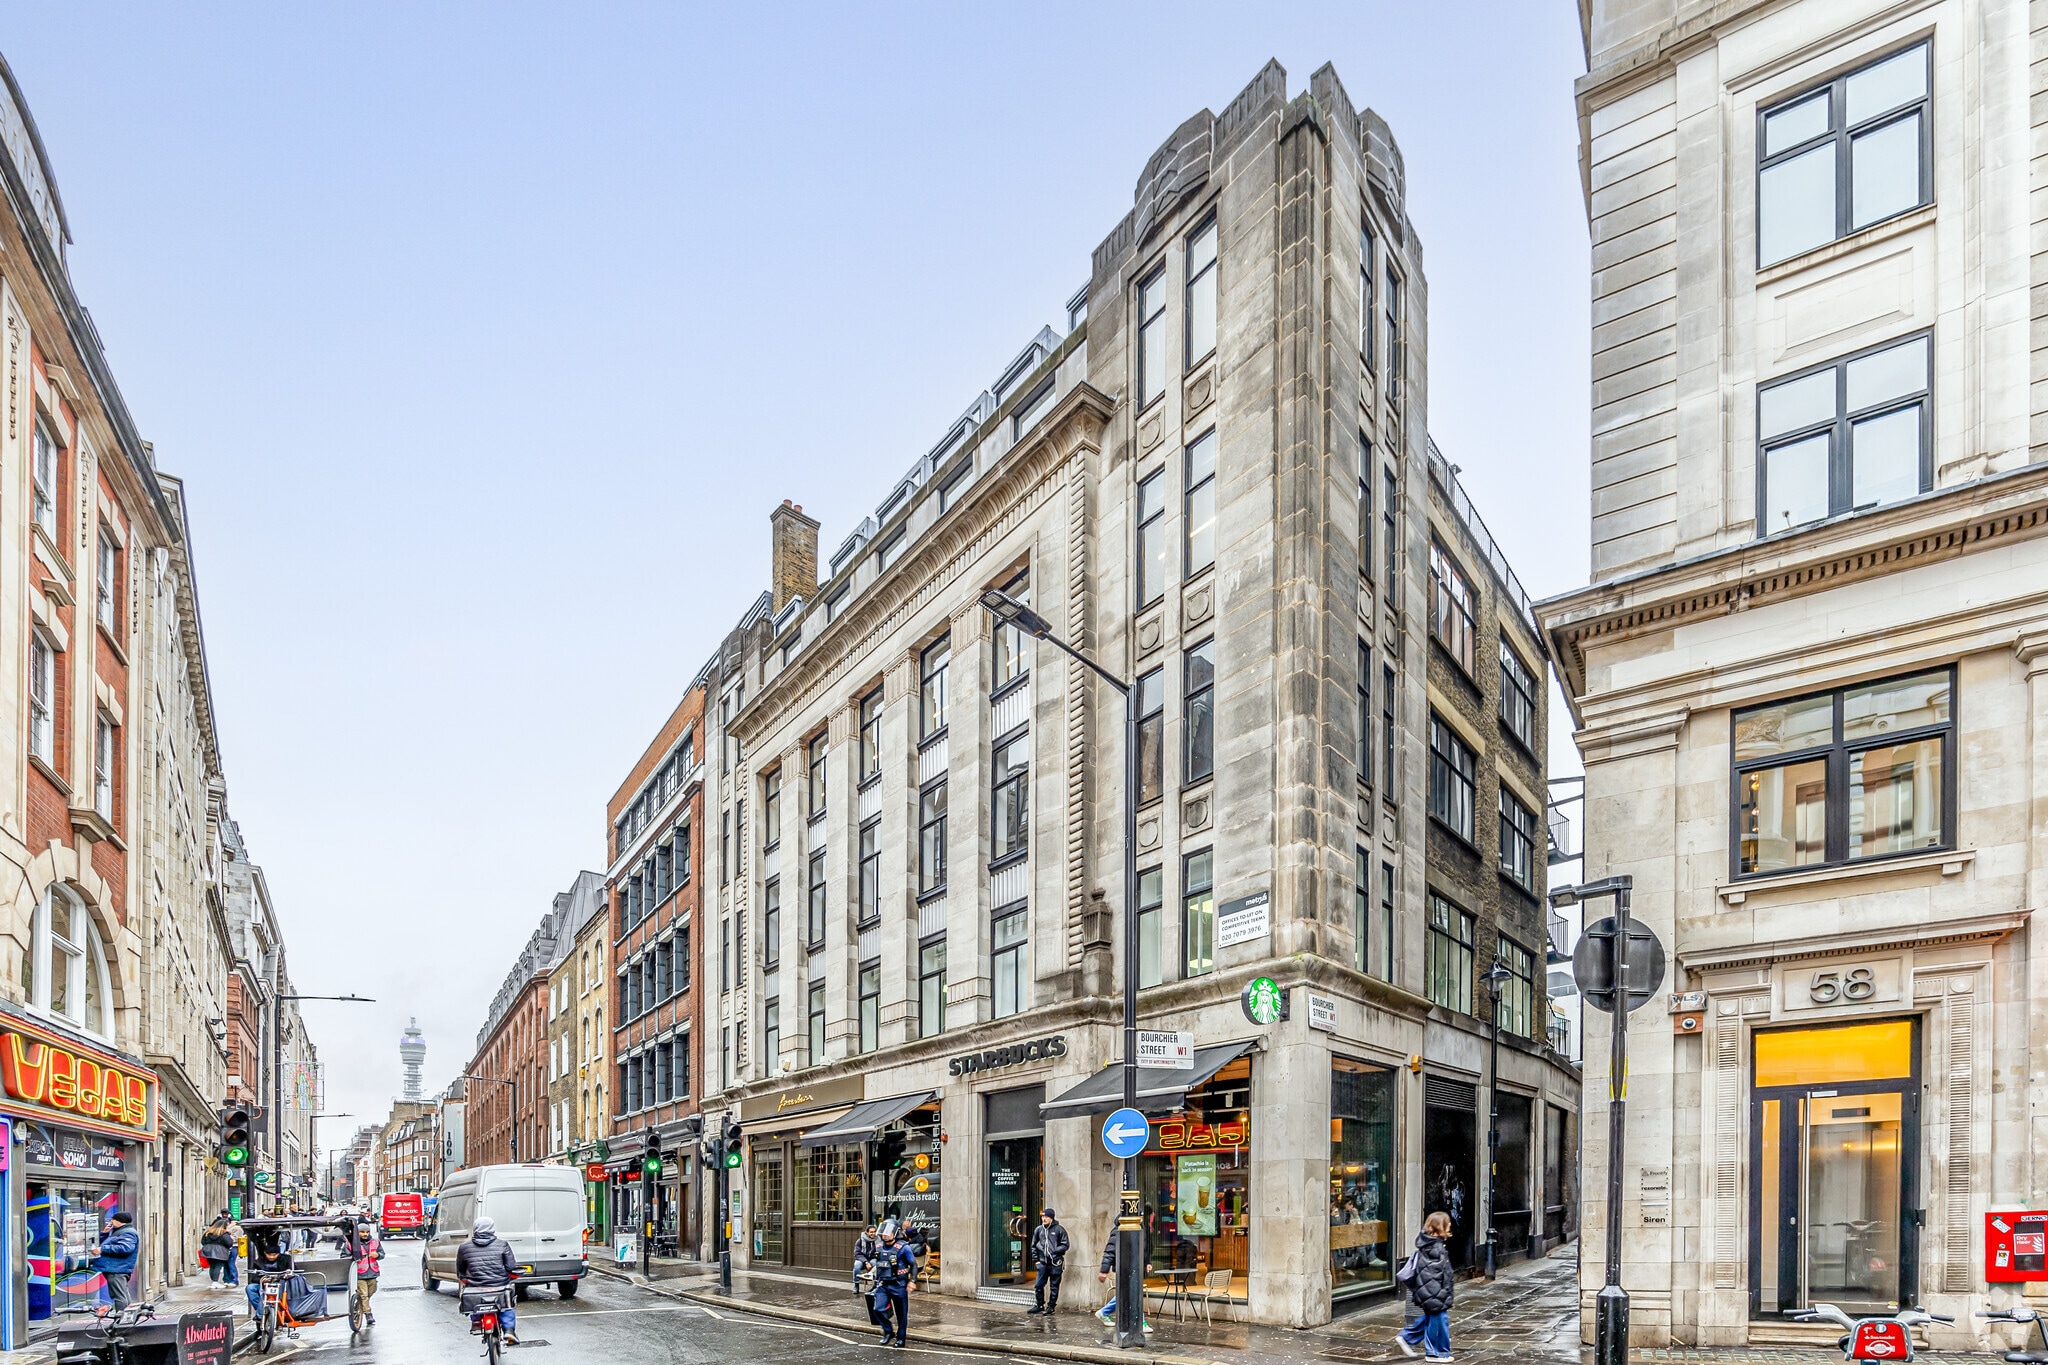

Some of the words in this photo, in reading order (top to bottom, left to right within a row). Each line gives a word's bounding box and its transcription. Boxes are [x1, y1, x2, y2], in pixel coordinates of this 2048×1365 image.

[1222, 916, 1239, 925] OFFICES
[1222, 920, 1250, 931] COMPETITIVE
[1251, 915, 1266, 923] TERMS
[1233, 930, 1246, 938] 7079
[1810, 966, 1876, 1003] 58
[1313, 1008, 1328, 1020] STREET
[1141, 1033, 1178, 1043] BOURCHIER
[949, 1035, 1068, 1077] STARBUCKS
[1141, 1045, 1166, 1055] STREET
[1177, 1047, 1186, 1055] W1
[0, 1032, 147, 1126] VEGAS
[63, 1136, 86, 1153] HELLO
[102, 1145, 116, 1157] PLAY
[63, 1151, 87, 1168] SOHO!
[97, 1155, 120, 1168] ANYTIME
[874, 1195, 886, 1203] Your
[887, 1193, 915, 1202] Starbucks
[916, 1193, 921, 1201] is
[905, 1207, 926, 1222] Hello
[184, 1322, 228, 1345] Absolutely
